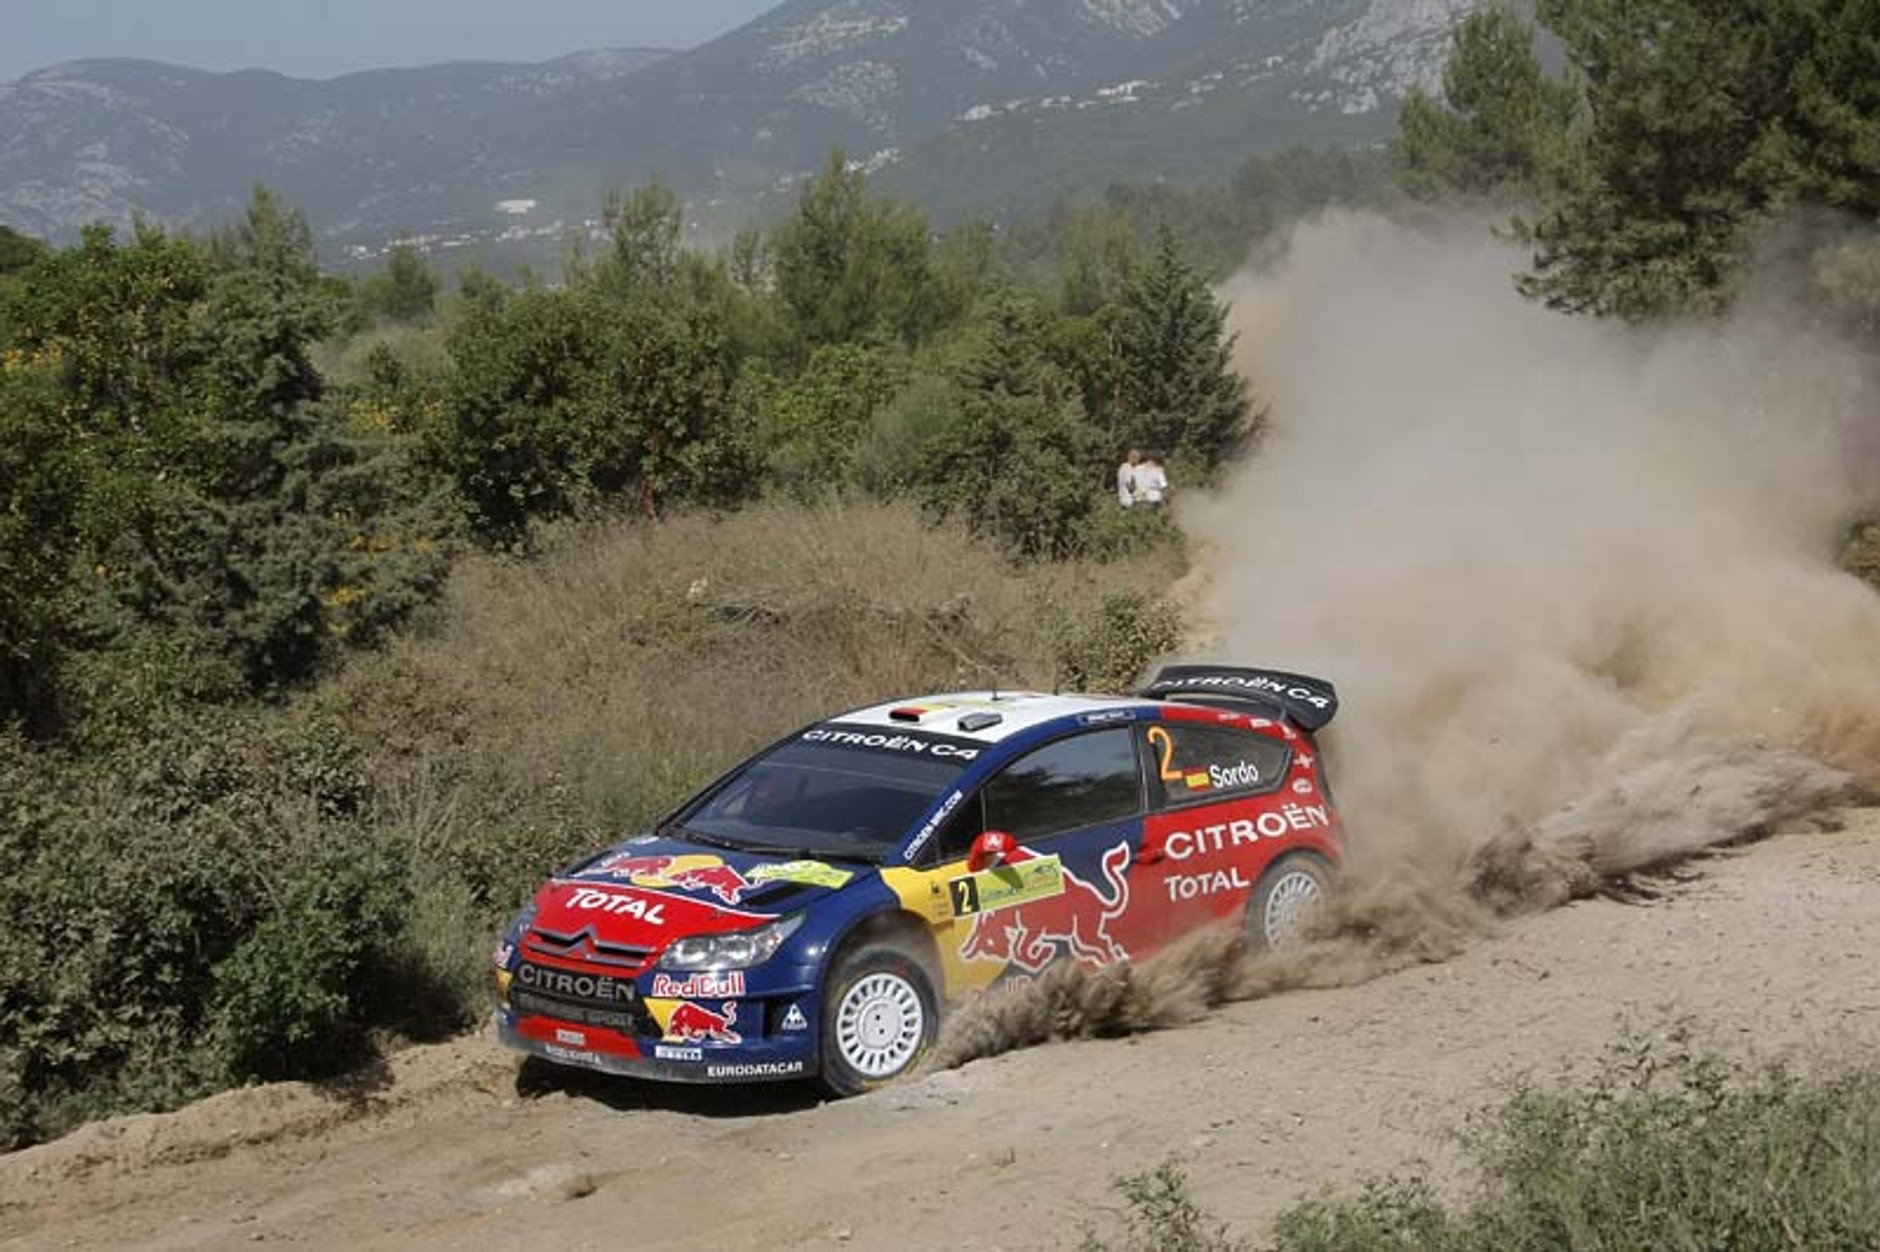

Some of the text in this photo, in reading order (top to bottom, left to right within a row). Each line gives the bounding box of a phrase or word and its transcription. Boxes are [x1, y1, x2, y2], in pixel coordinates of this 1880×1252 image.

[803, 730, 980, 760] CITROËN C4
[1147, 726, 1183, 780] 2
[1209, 760, 1259, 788] Sordo
[1163, 803, 1329, 860] CITROËN
[958, 880, 973, 913] 2
[1164, 867, 1250, 903] TOTAL
[565, 888, 666, 925] TOTAL
[519, 963, 636, 1001] CITROËN
[651, 970, 746, 997] Red Bull
[707, 1061, 803, 1077] EURODATACAR
